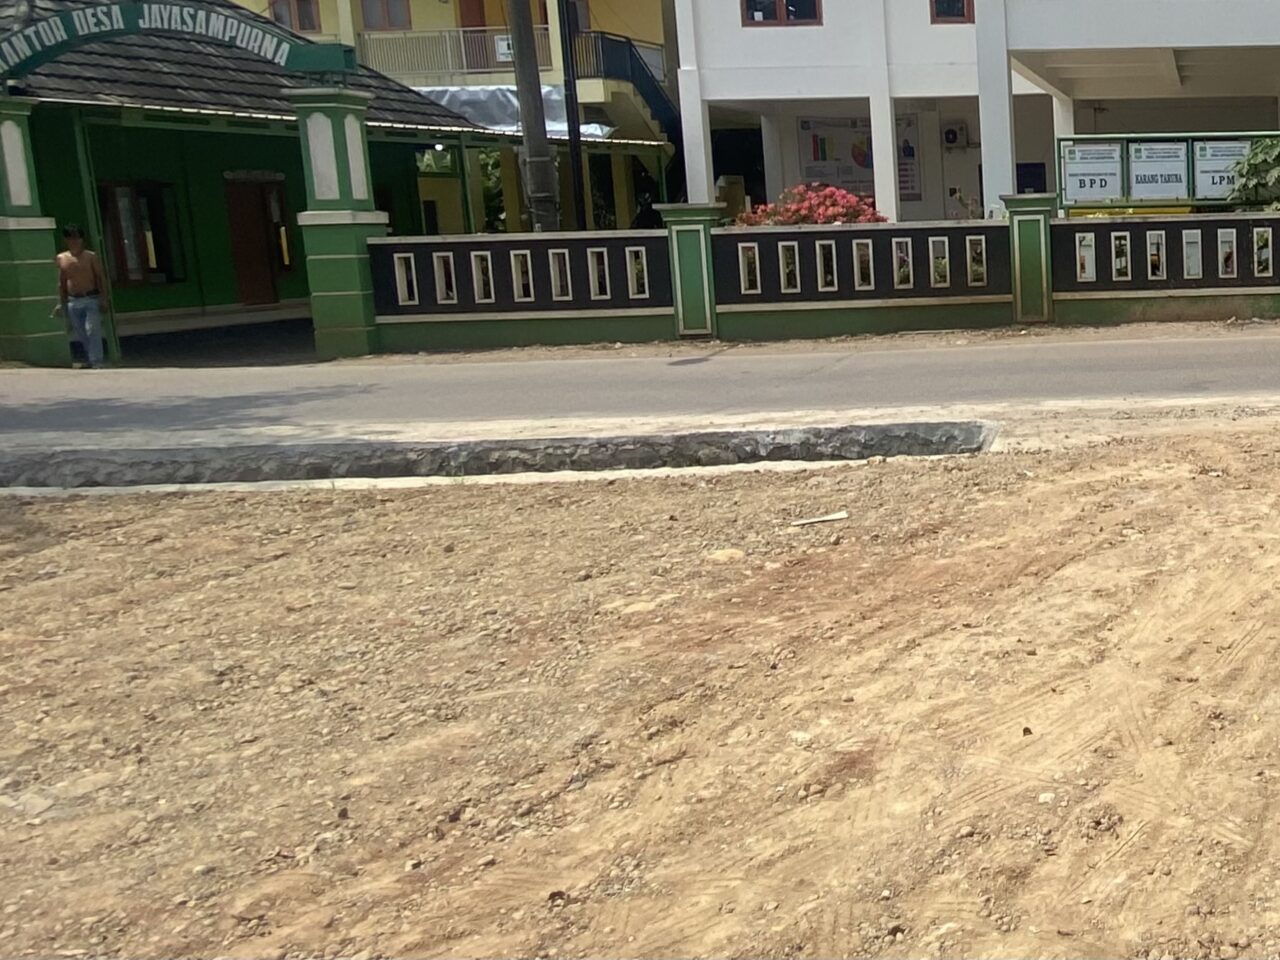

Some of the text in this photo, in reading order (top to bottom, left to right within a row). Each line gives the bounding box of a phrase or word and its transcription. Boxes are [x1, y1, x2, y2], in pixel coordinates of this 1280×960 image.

[72, 4, 125, 36] DESA
[138, 3, 291, 66] JAYASAMPURNA
[1079, 178, 1107, 189] BPD
[1135, 173, 1183, 184] KARANG TARUNA
[1211, 175, 1236, 185] LPM
